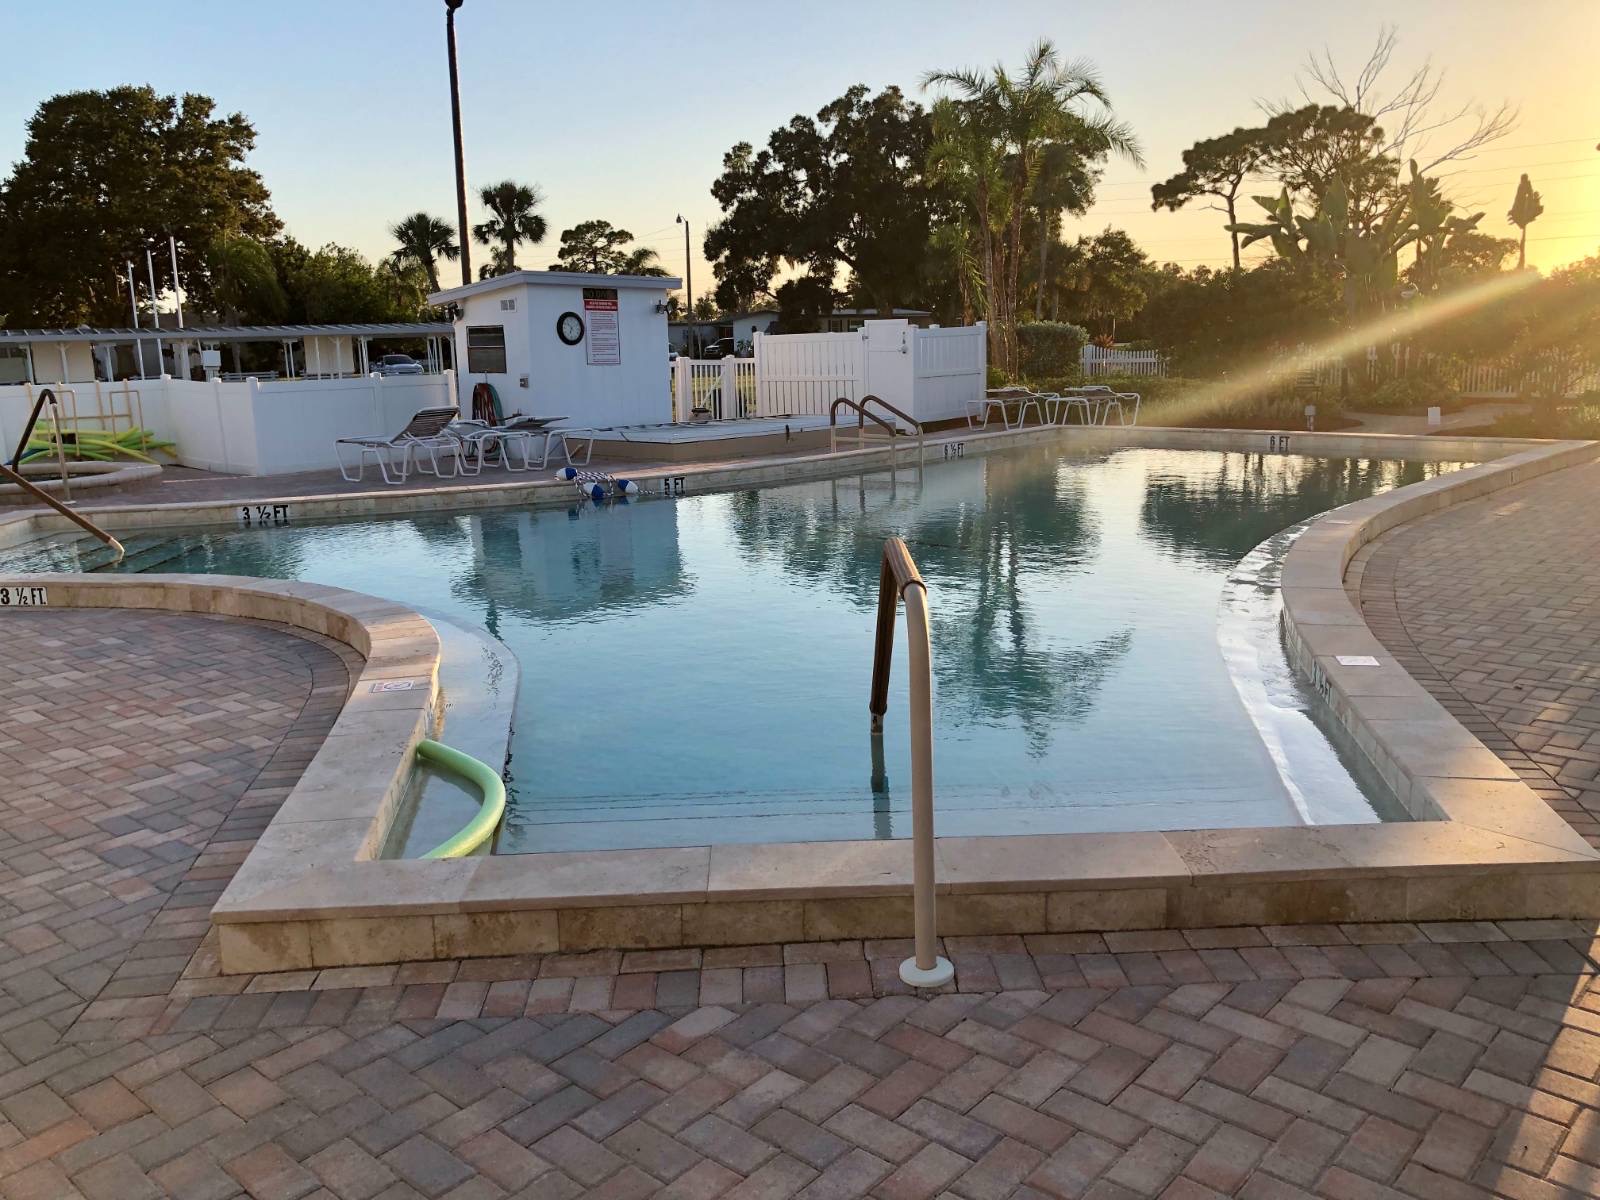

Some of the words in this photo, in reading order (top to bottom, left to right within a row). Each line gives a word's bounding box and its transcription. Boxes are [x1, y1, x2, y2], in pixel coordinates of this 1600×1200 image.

[1279, 436, 1290, 447] FT
[664, 478, 670, 490] 5
[674, 477, 685, 489] FT
[242, 506, 250, 520] 3
[273, 504, 288, 519] FT
[0, 587, 10, 605] 3
[31, 587, 47, 605] FT.
